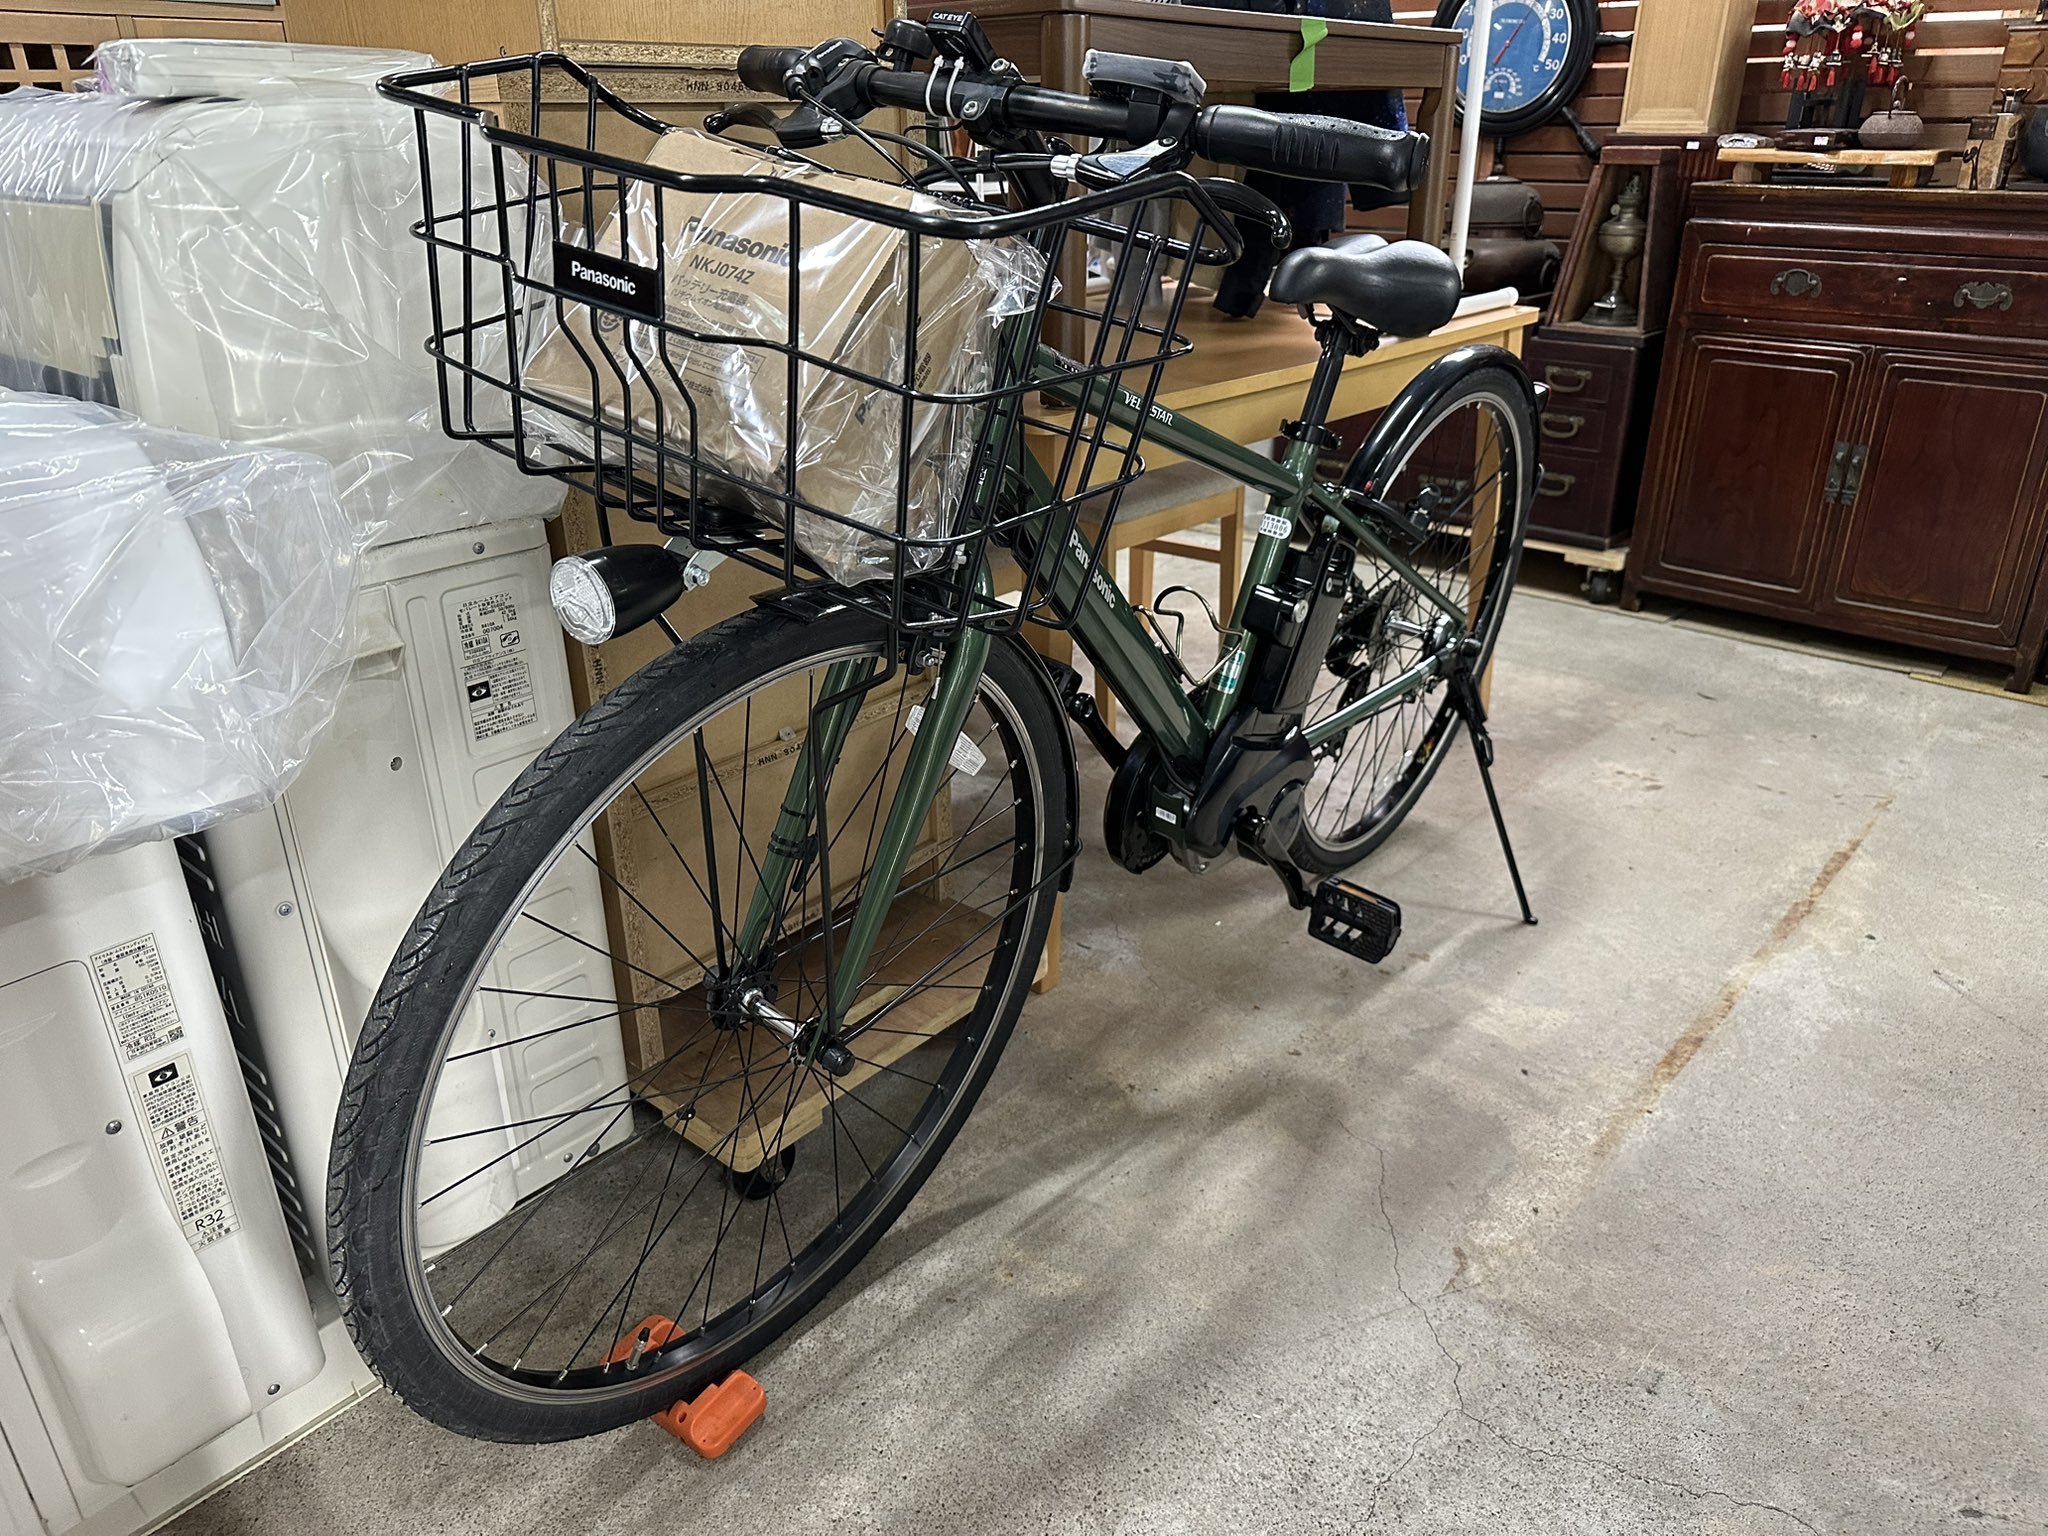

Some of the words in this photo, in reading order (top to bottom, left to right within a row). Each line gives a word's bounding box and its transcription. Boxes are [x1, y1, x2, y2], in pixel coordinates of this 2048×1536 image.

[932, 12, 964, 22] CATEYE
[1549, 8, 1564, 20] 30
[1551, 32, 1567, 44] 40
[1544, 59, 1560, 71] 50
[685, 79, 750, 92] HNN-9046
[689, 254, 756, 285] NKJ074Z
[571, 260, 636, 296] Panasonic
[1069, 528, 1116, 608] Pansonic
[174, 1115, 199, 1132] 警告
[194, 1209, 225, 1231] R32
